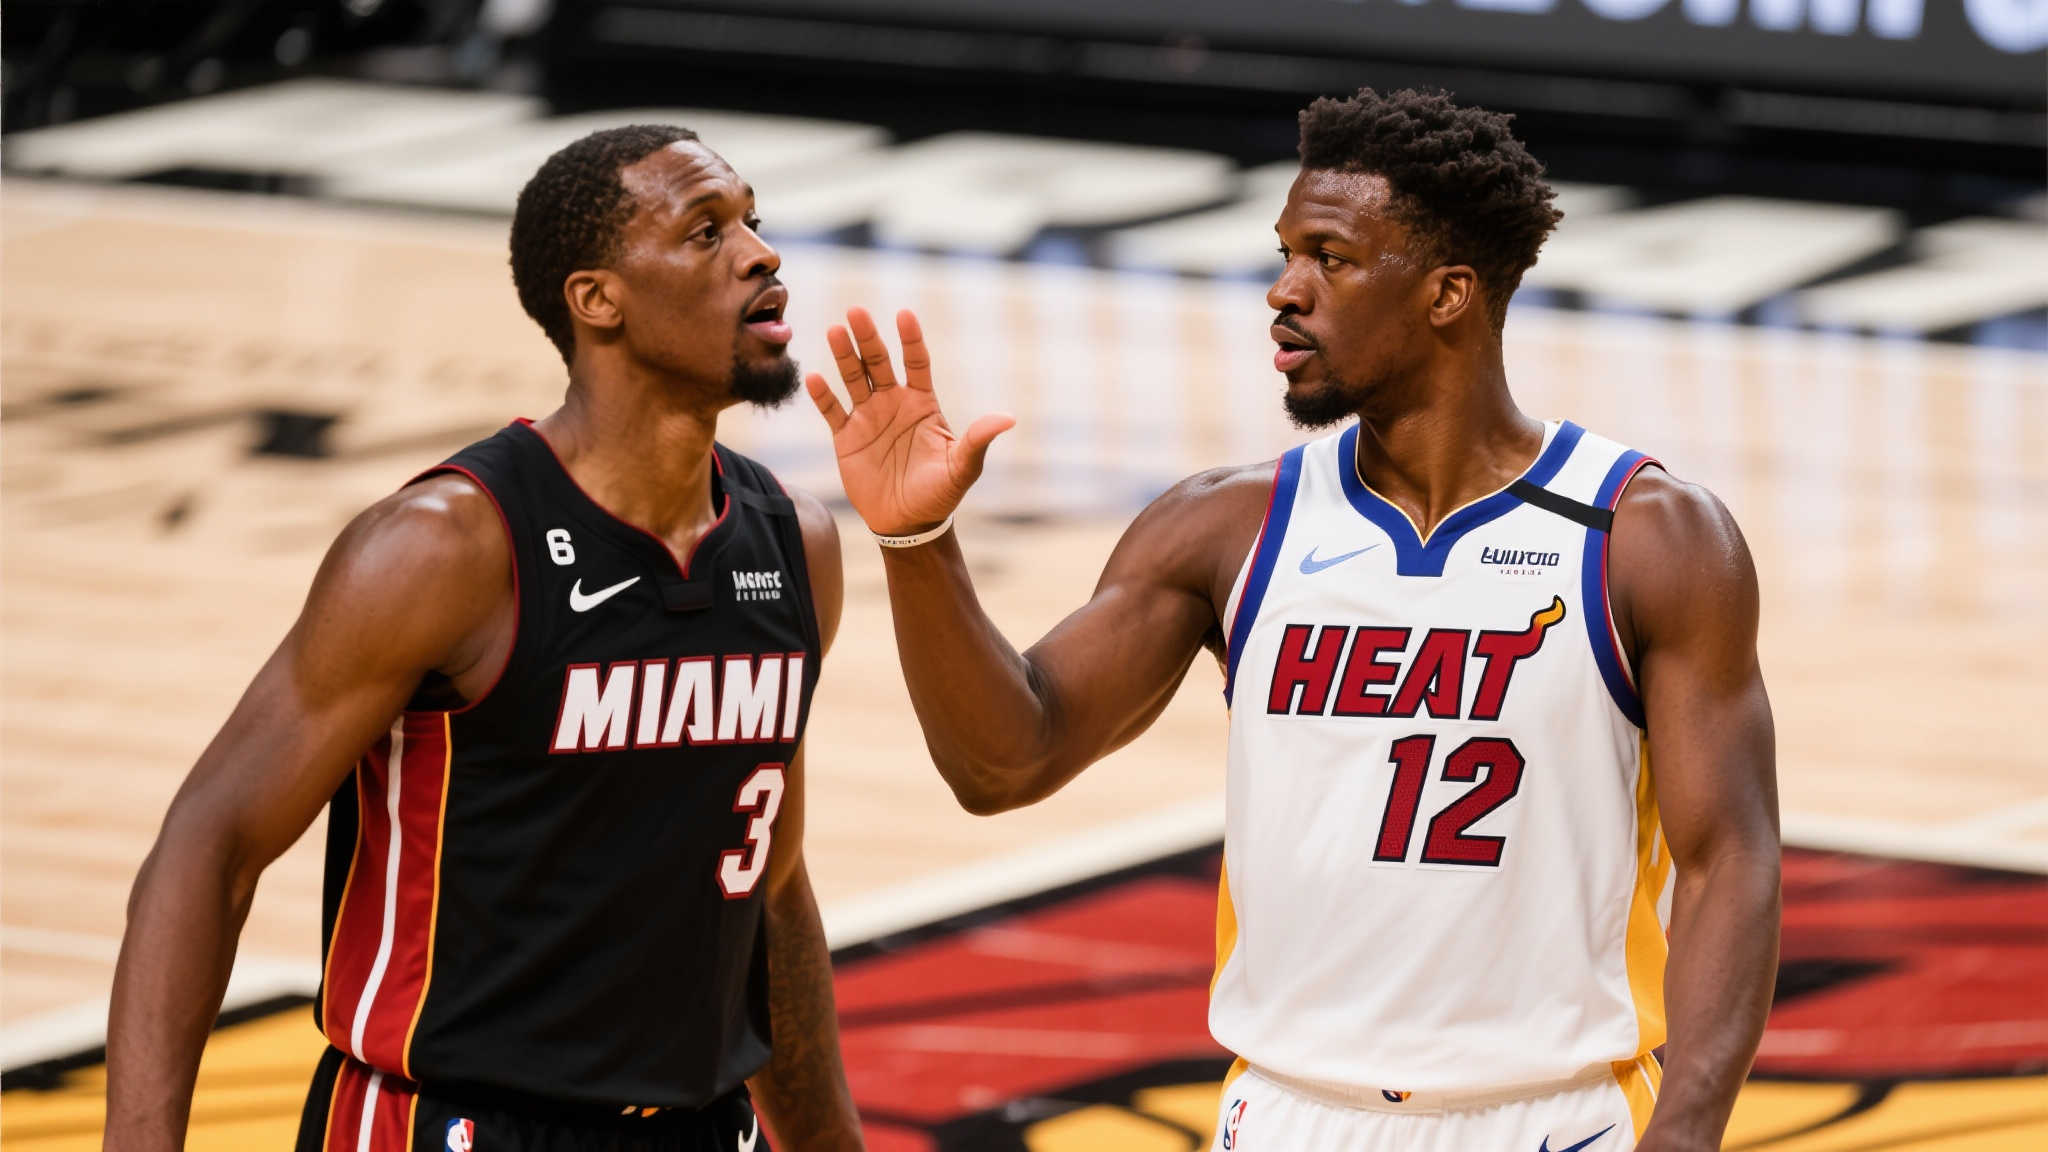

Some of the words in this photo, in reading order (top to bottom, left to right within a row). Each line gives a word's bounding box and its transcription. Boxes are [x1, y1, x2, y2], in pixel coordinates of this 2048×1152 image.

[546, 528, 576, 566] 6
[548, 651, 807, 755] MIAMI
[1267, 595, 1566, 721] HEAT
[715, 762, 785, 900] 3
[1372, 734, 1526, 867] 12
